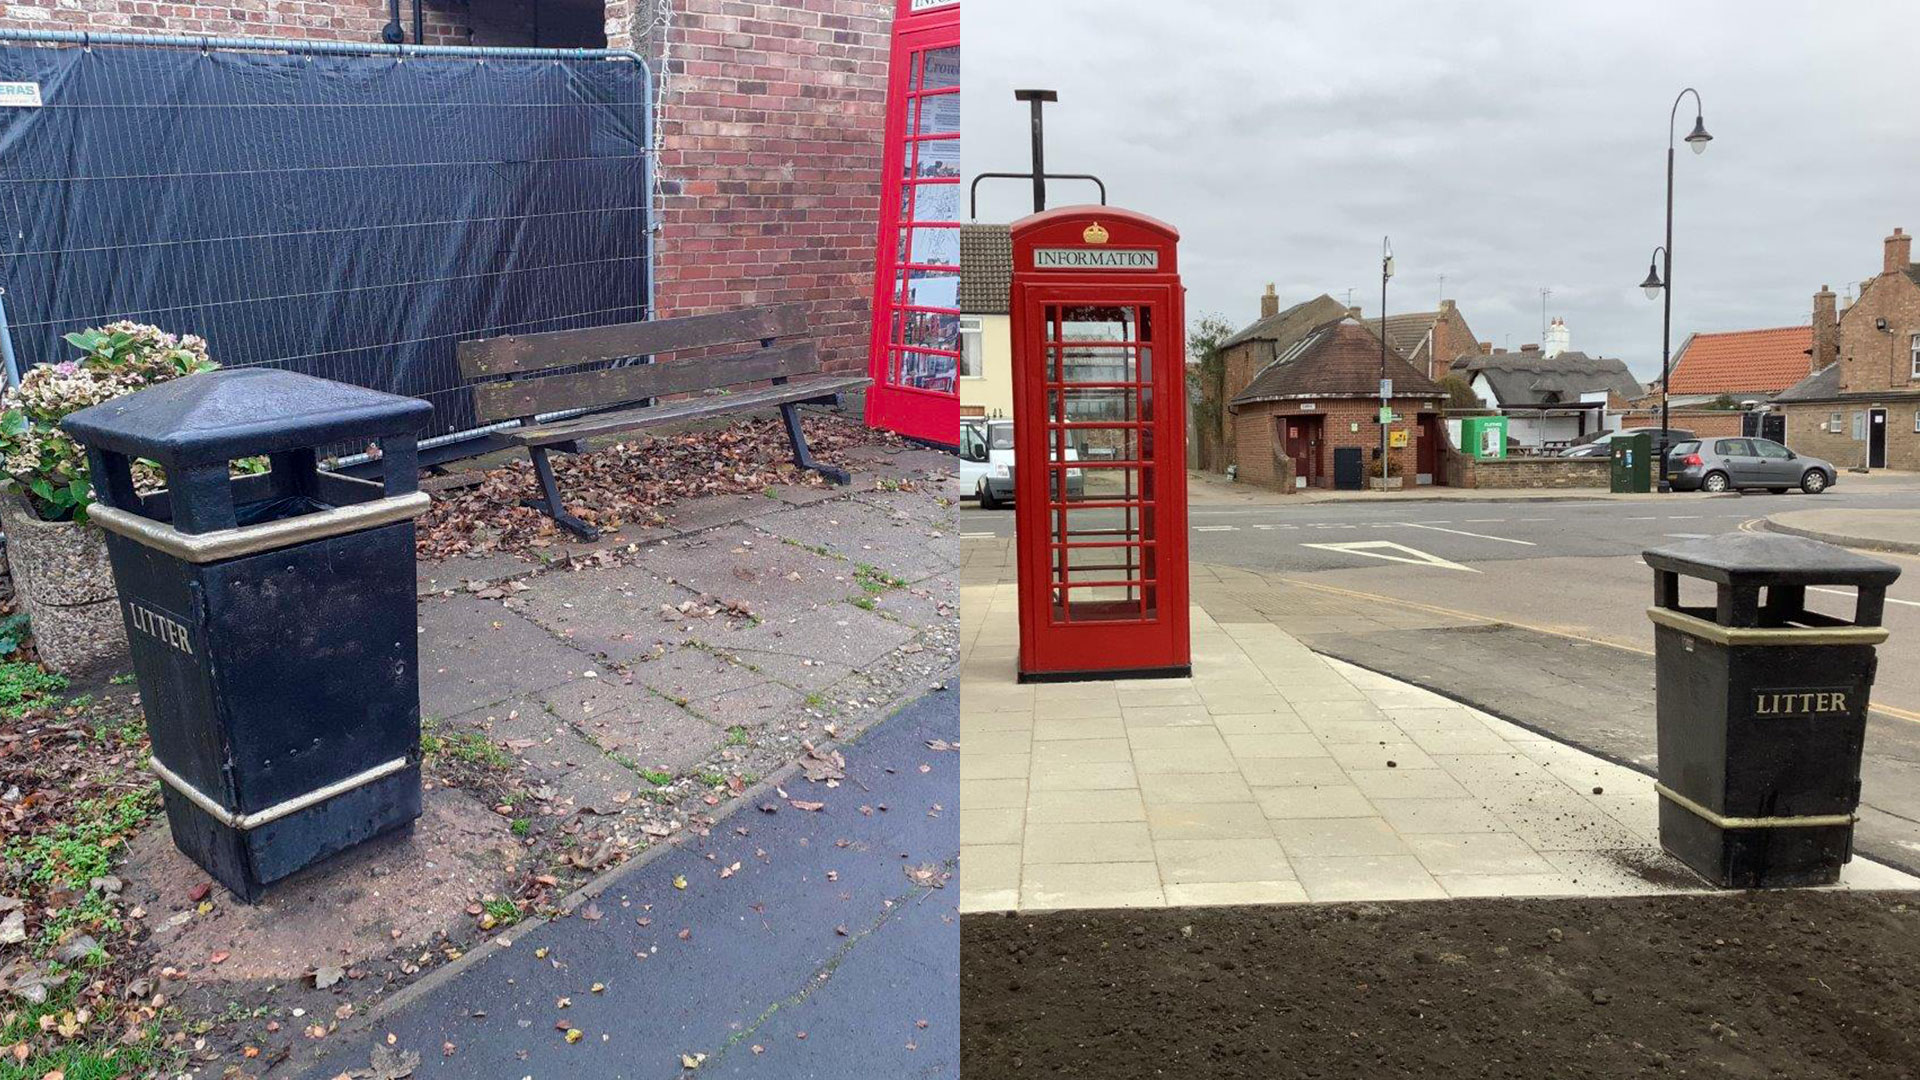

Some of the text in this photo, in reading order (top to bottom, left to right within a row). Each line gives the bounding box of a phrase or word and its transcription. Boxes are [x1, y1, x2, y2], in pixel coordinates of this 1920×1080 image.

[1038, 251, 1154, 266] INFORMATION
[129, 602, 193, 655] LITTER
[1756, 692, 1847, 713] LITTER
